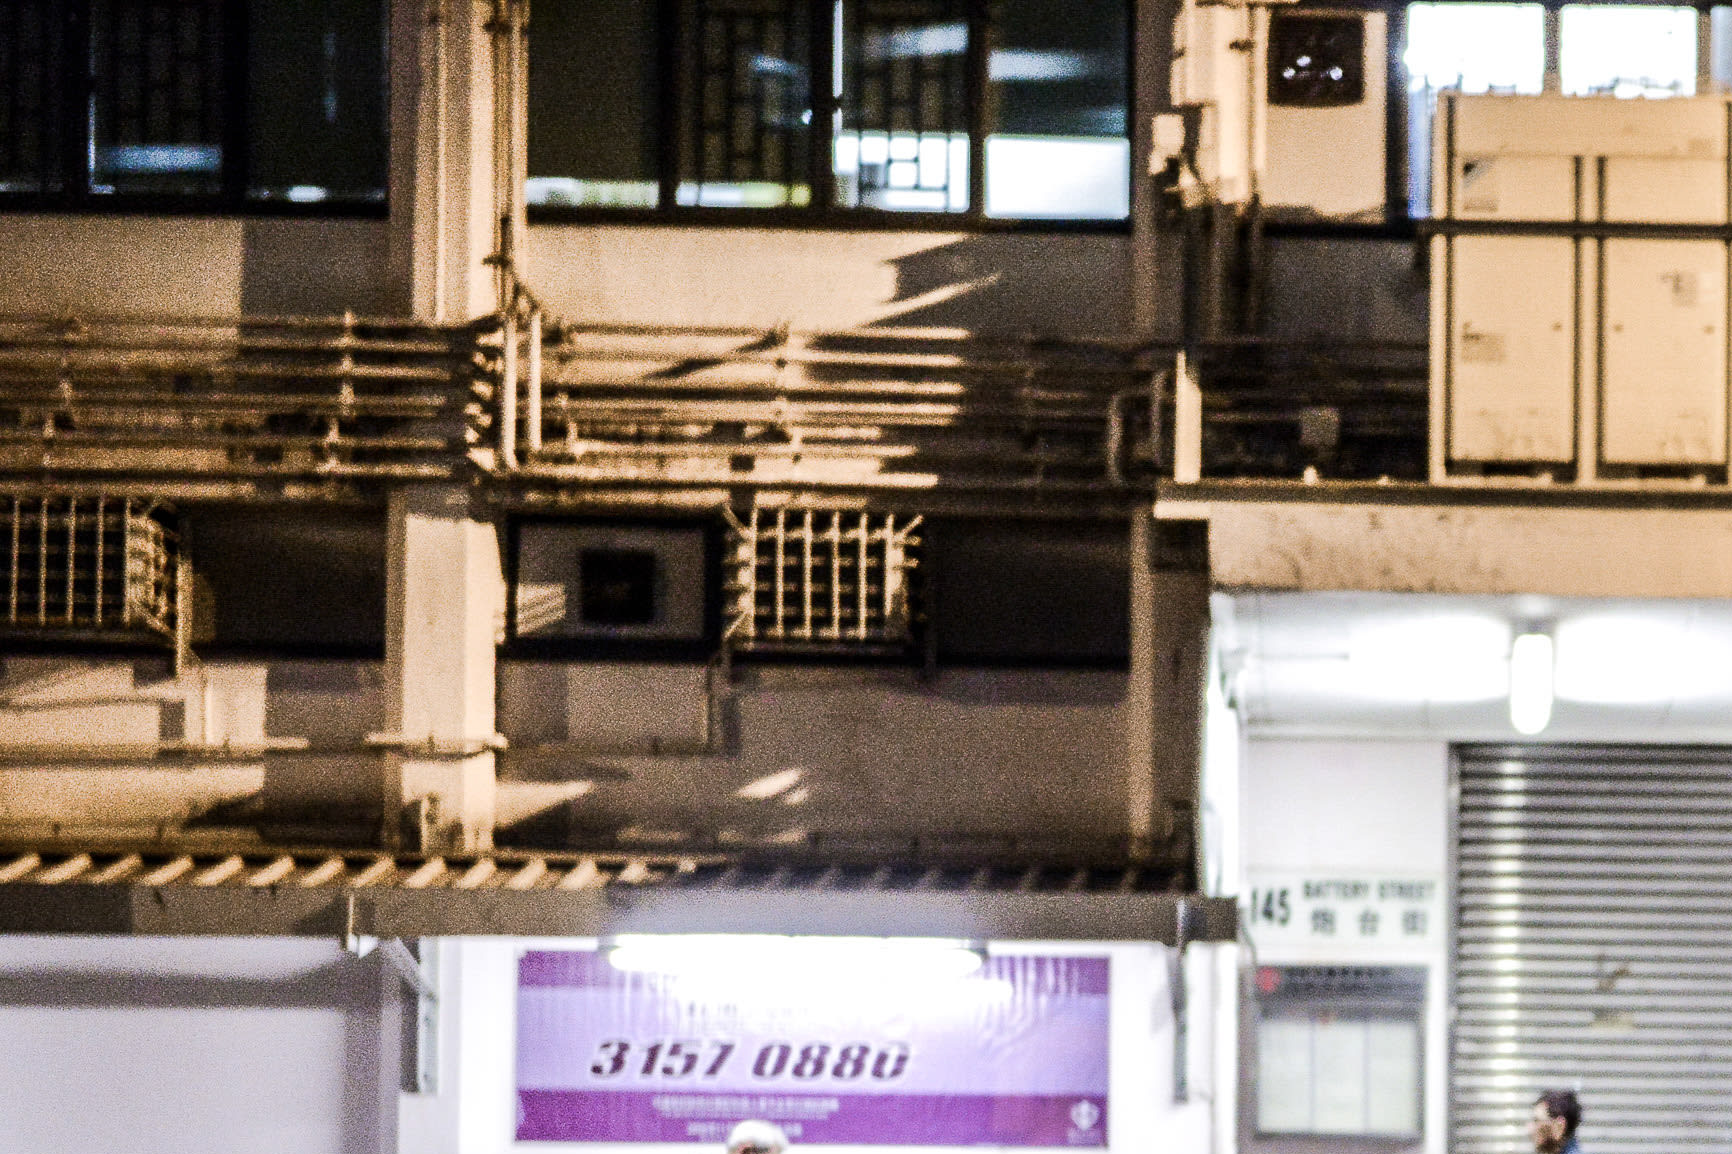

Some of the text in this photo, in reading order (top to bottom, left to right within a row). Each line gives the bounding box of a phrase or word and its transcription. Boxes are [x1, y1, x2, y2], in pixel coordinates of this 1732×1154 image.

[1250, 887, 1291, 927] 145
[1303, 879, 1436, 900] BATTERY STREET
[590, 1041, 910, 1079] 3157 0880
